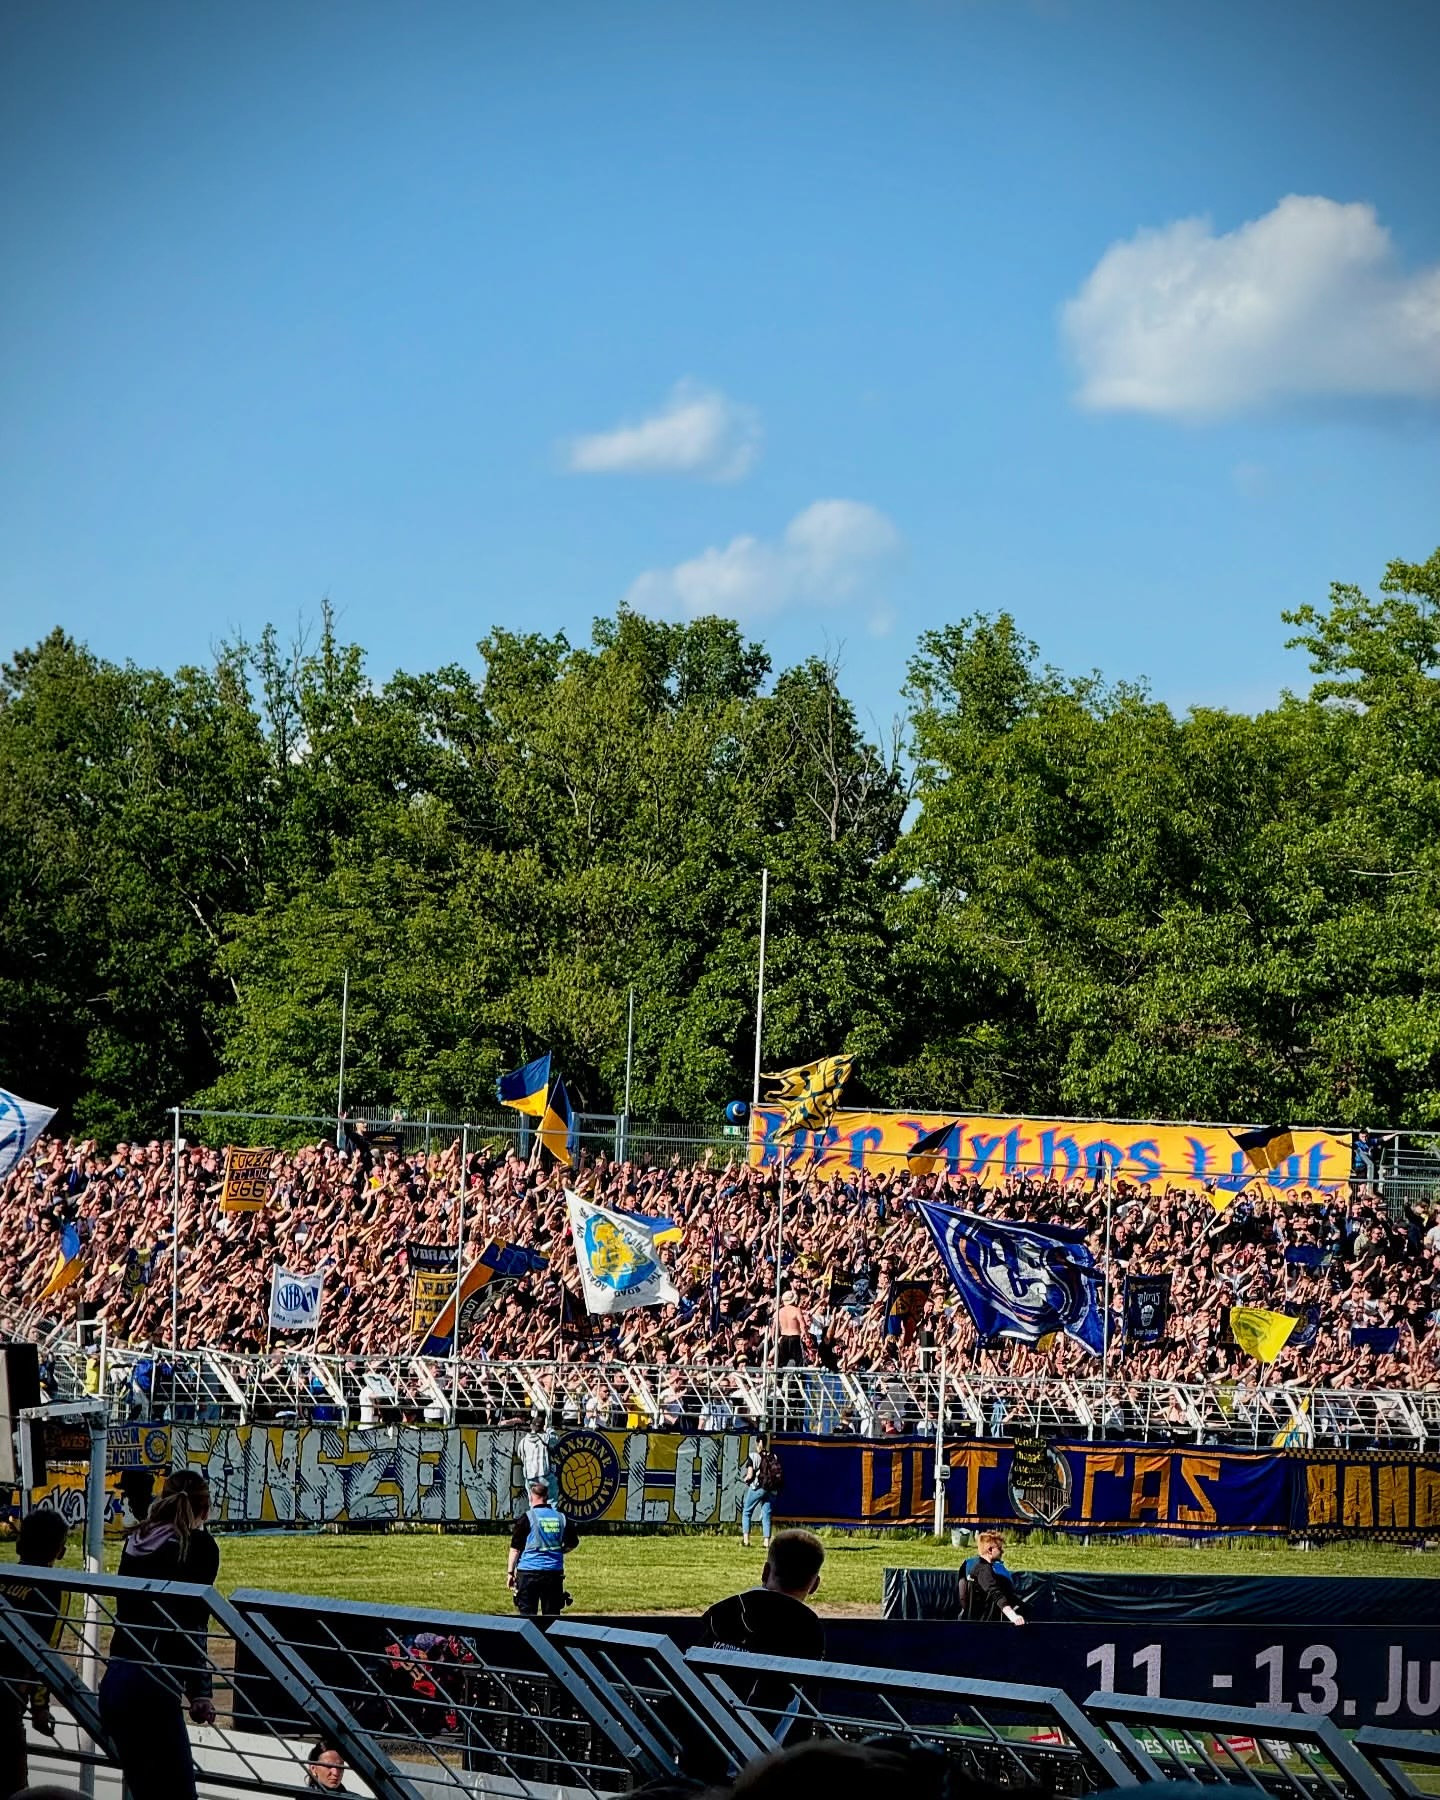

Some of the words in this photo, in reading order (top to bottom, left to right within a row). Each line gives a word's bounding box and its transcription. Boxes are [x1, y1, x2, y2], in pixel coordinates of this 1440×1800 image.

[230, 1151, 273, 1169] FORZA
[896, 1119, 1163, 1187] Mythos
[227, 1181, 266, 1198] 1966
[281, 1284, 301, 1309] VfB
[551, 1436, 613, 1468] FANSZENE
[623, 1432, 769, 1522] LOK
[557, 1477, 614, 1517] KOMOTIVE
[1086, 1643, 1162, 1697] 11
[1212, 1674, 1233, 1689] -
[1255, 1644, 1357, 1718] 13.
[1375, 1645, 1440, 1717] Ju
